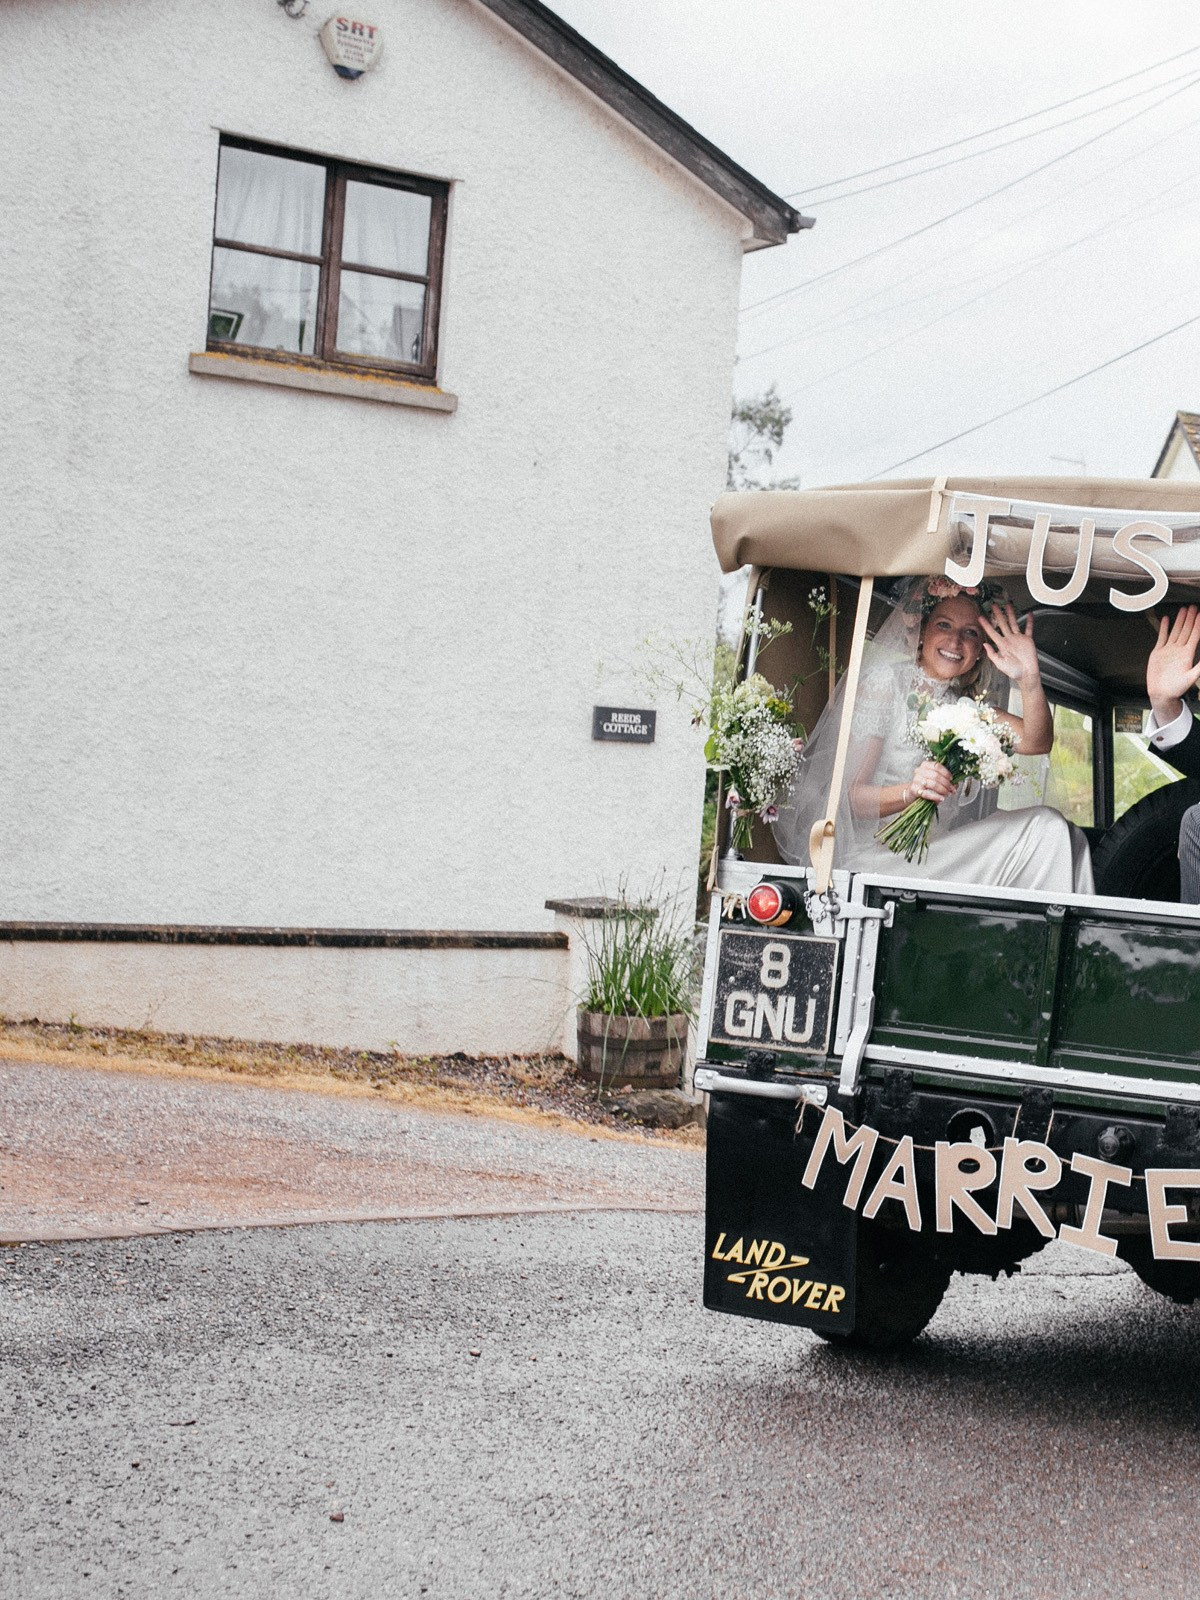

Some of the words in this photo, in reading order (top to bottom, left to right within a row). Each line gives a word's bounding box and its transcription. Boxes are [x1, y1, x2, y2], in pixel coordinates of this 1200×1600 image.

[336, 17, 378, 39] SRT
[603, 722, 648, 735] COTTAGE
[611, 712, 642, 724] REEDS
[760, 942, 791, 989] 8
[724, 990, 817, 1044] GNU
[711, 1232, 786, 1268] LAND
[745, 1271, 846, 1313] ROVER
